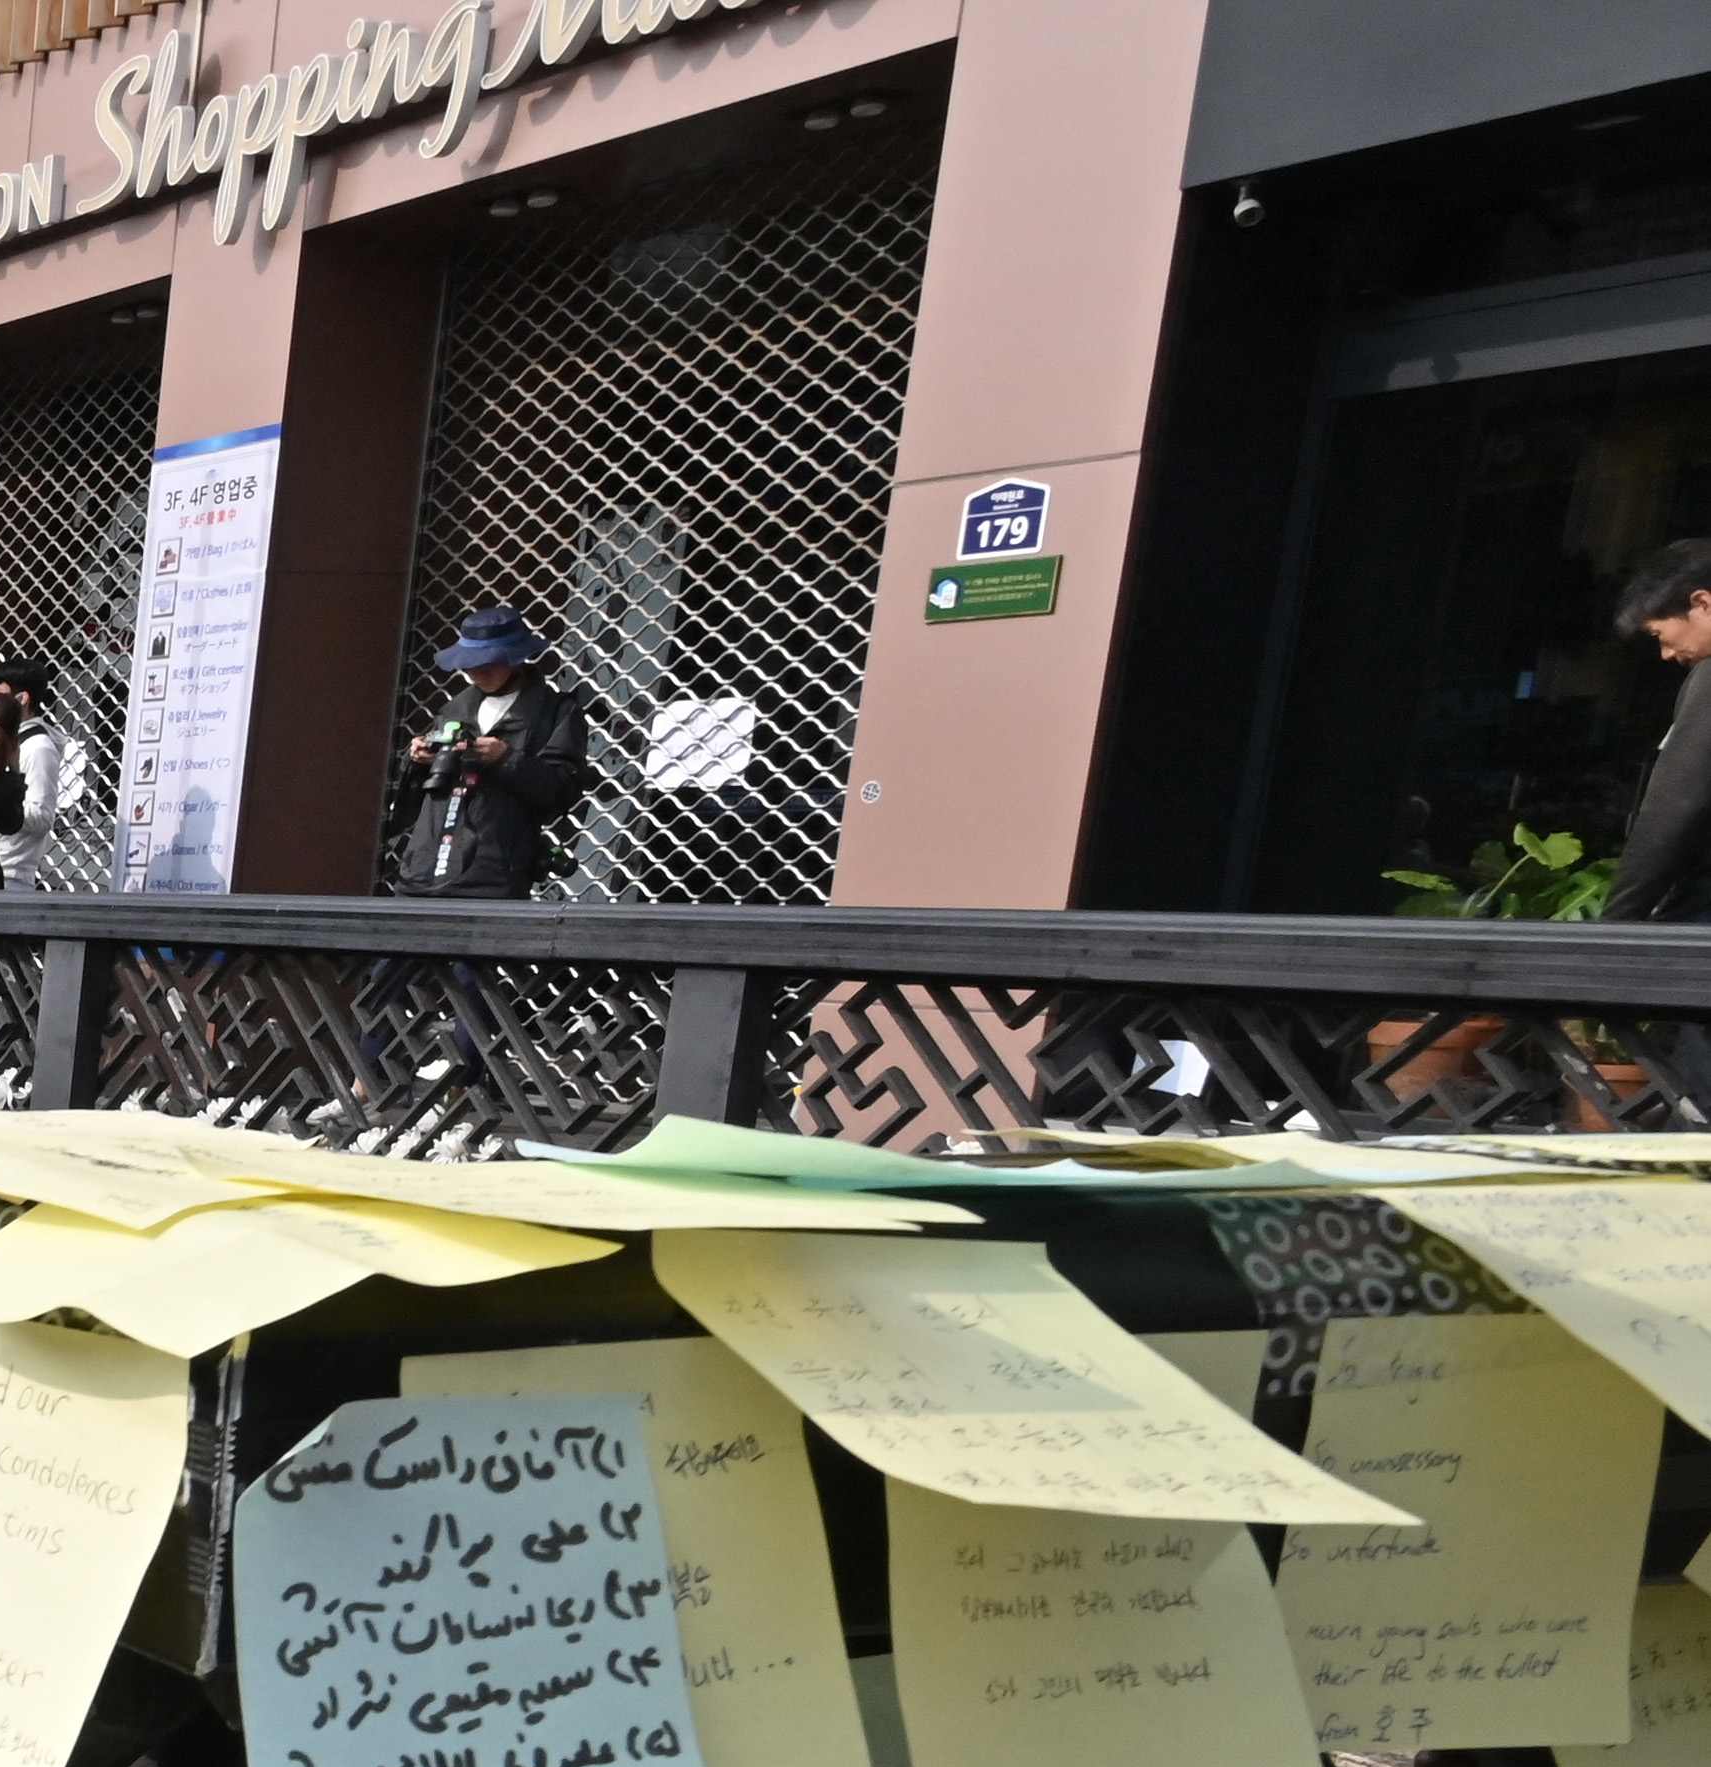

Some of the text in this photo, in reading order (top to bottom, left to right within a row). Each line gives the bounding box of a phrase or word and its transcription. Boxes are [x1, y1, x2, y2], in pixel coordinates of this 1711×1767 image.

[75, 0, 487, 245] Shopping
[189, 484, 209, 507] 4F
[213, 475, 259, 505] 영업중
[976, 515, 1030, 549] 179
[196, 708, 228, 722] Jewelry
[184, 758, 209, 771] Shoes
[15, 1385, 72, 1418] our
[1372, 1620, 1431, 1662] young
[1425, 1658, 1451, 1684] to
[1454, 1657, 1486, 1683] the
[1493, 1649, 1562, 1683] fullest
